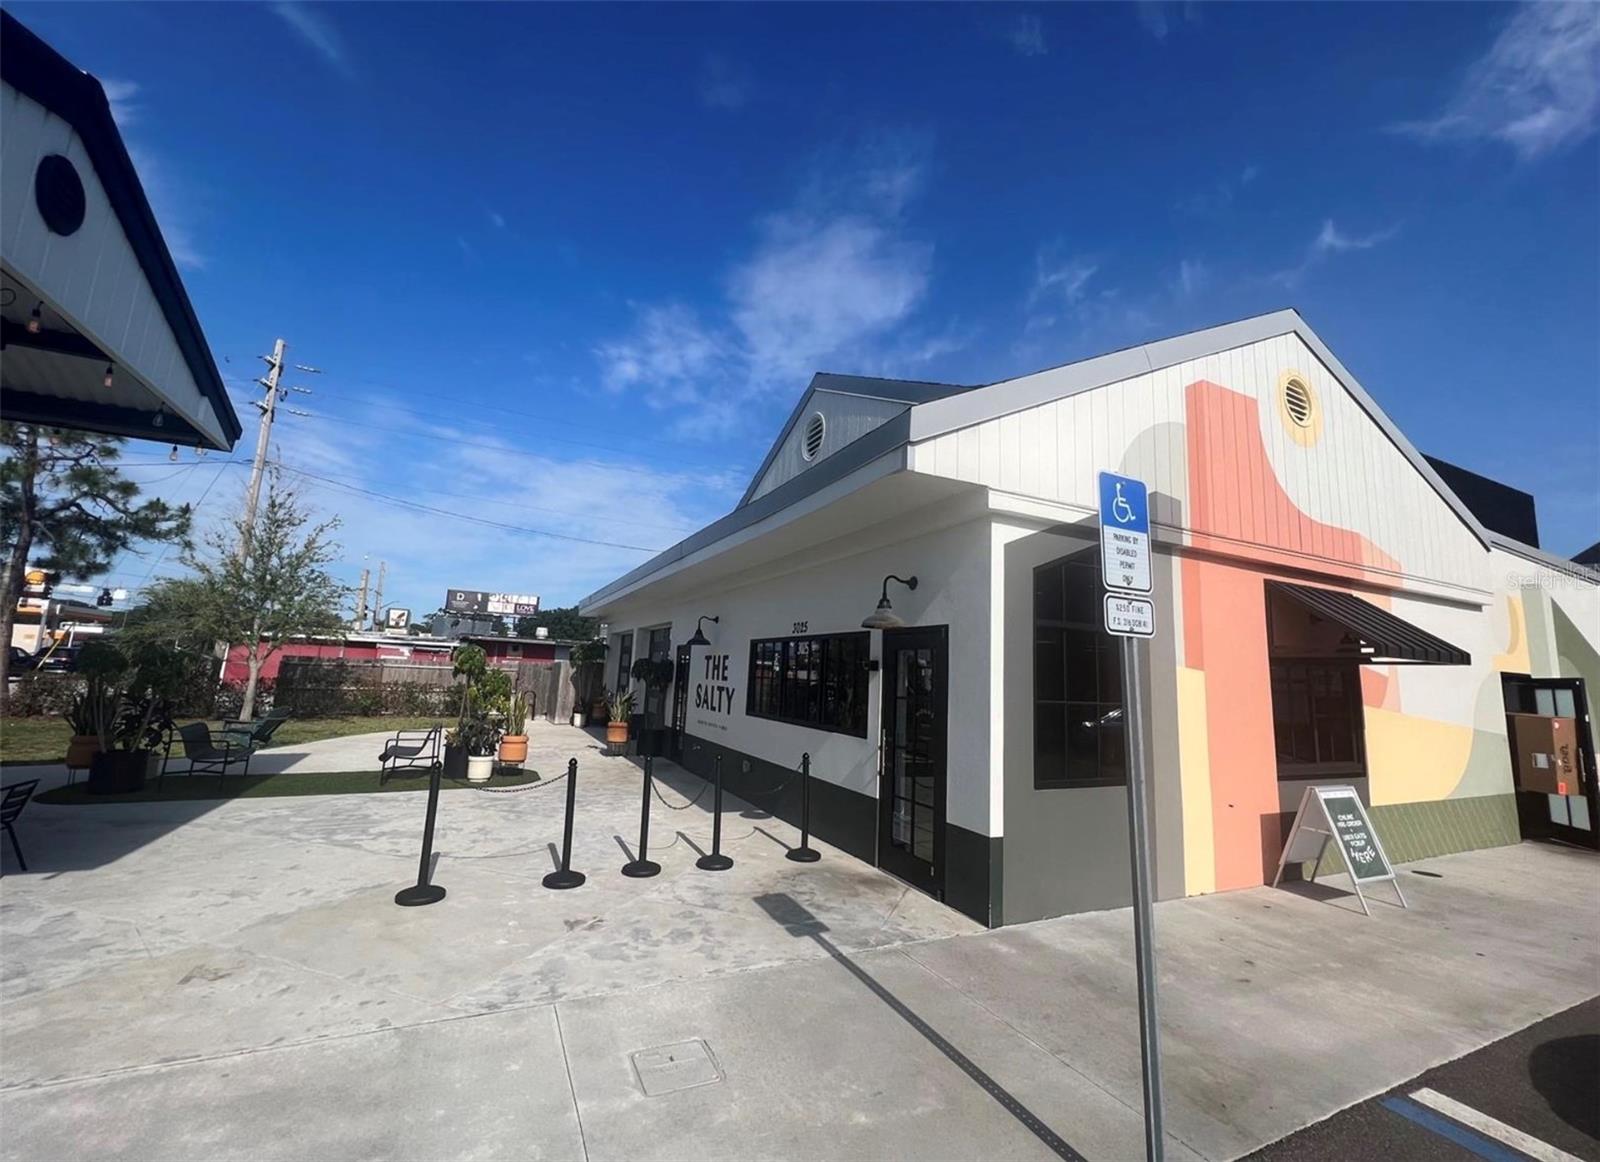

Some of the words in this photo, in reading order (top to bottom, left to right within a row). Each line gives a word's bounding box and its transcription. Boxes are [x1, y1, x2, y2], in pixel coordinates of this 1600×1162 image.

[1113, 533, 1131, 544] PARKING
[1132, 536, 1139, 545] BY
[1116, 546, 1137, 558] DISABLED
[1119, 560, 1135, 570] PERMIT
[1115, 602, 1130, 613] $250
[705, 654, 729, 681] THE
[695, 683, 735, 716] SALTY
[1350, 845, 1376, 864] HERE
